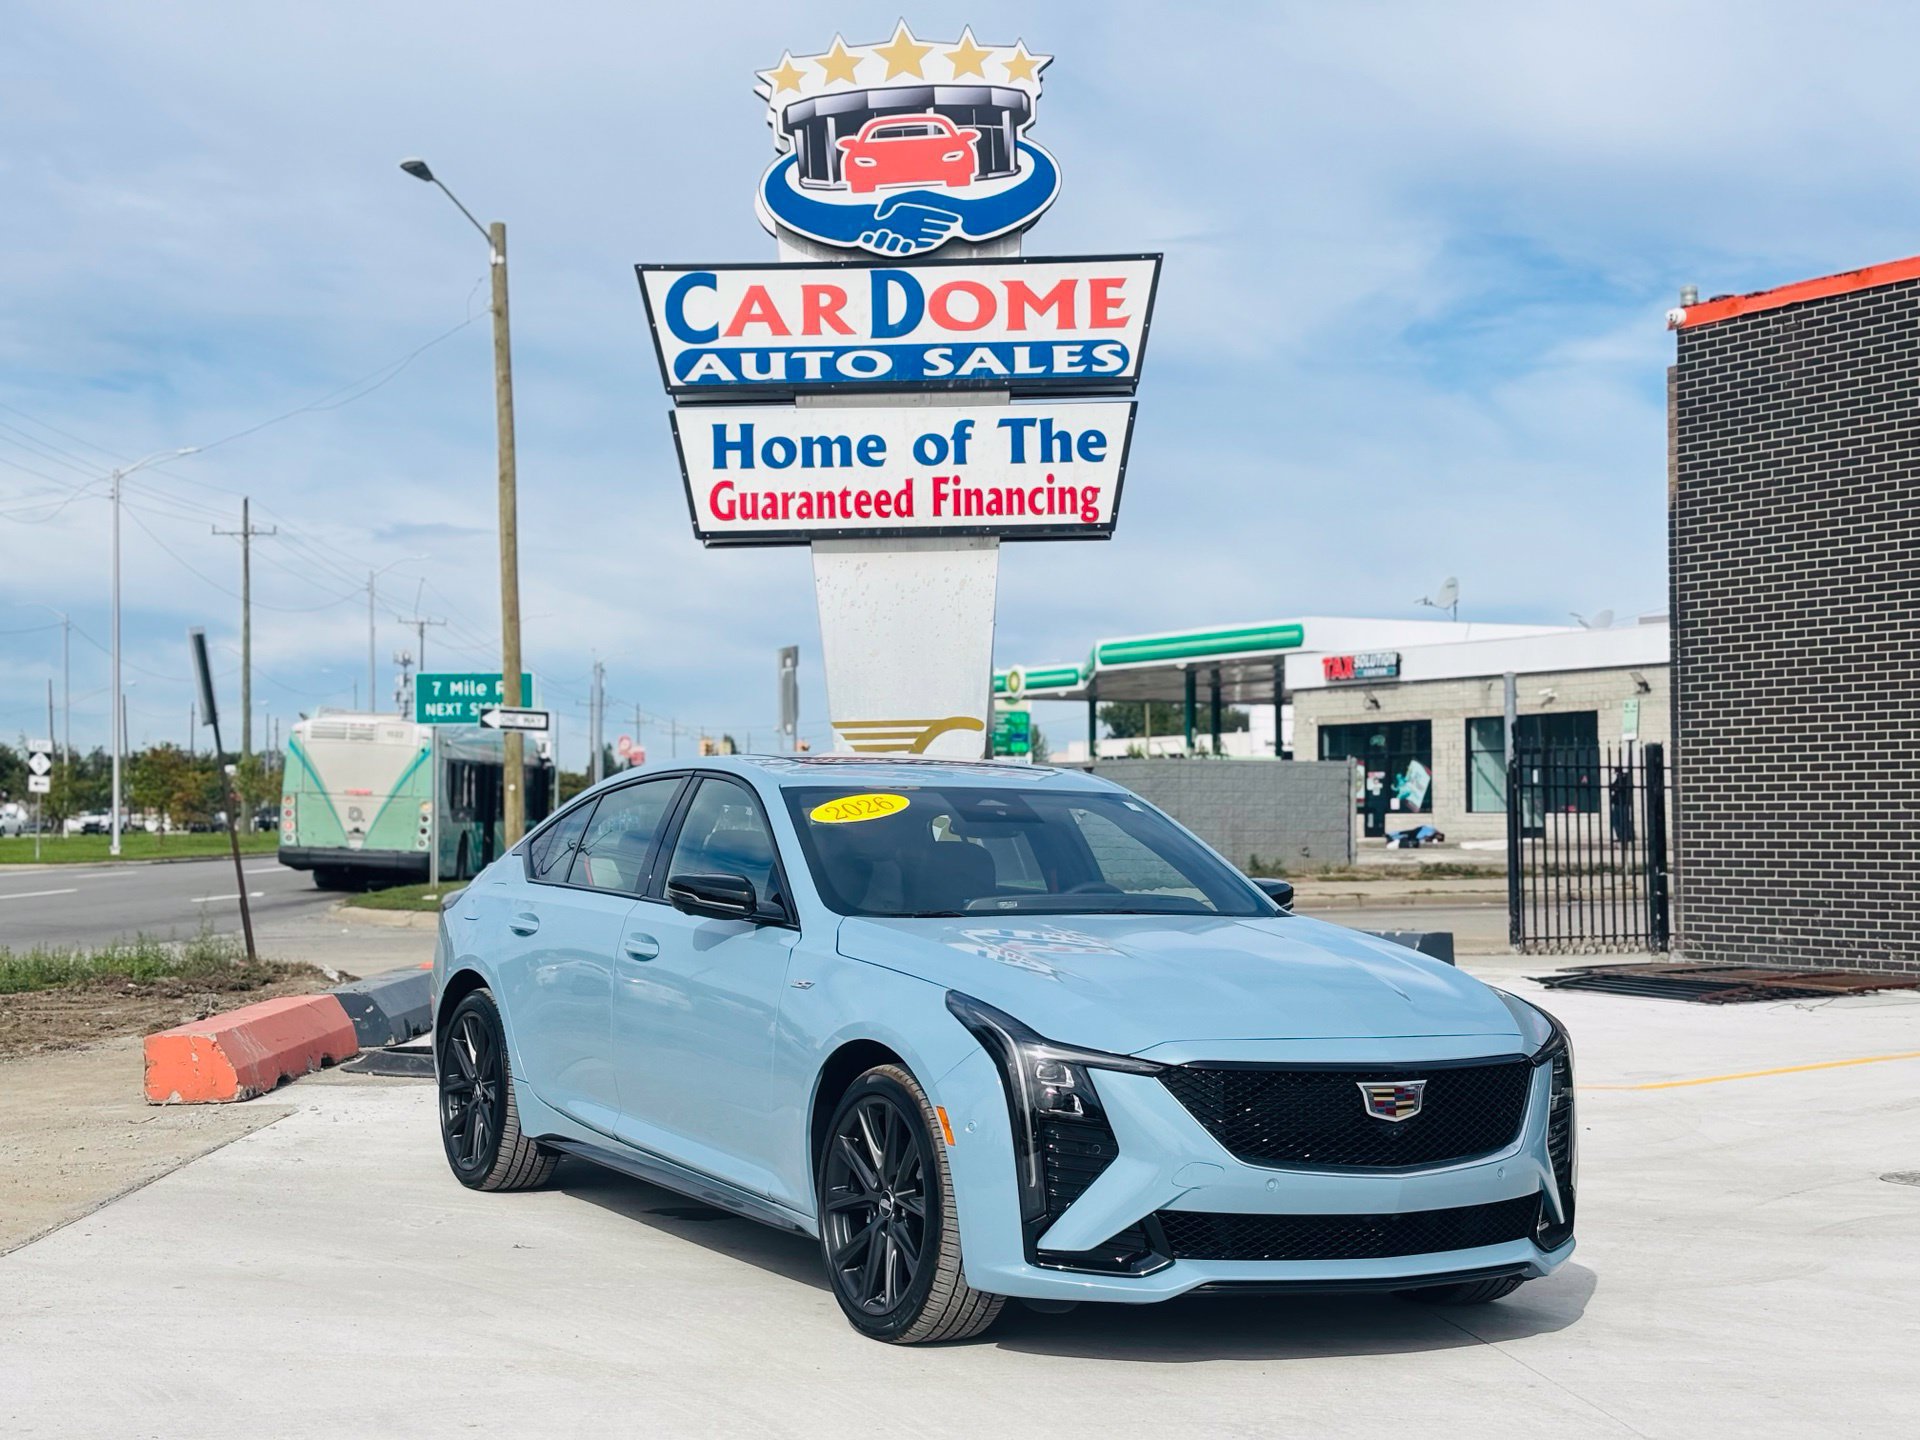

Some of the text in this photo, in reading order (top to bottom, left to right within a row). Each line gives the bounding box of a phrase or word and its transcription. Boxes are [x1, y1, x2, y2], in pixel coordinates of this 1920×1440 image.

[682, 344, 1121, 382] AUTO SALES
[711, 417, 1107, 469] Home of The
[709, 473, 1101, 523] Guaranteed Financing
[1322, 652, 1397, 680] TAX SOLUTION
[431, 681, 442, 697] 7
[449, 680, 487, 697] Mile
[425, 702, 463, 717] NEXT
[523, 716, 543, 724] WAY
[825, 797, 895, 820] 2026
